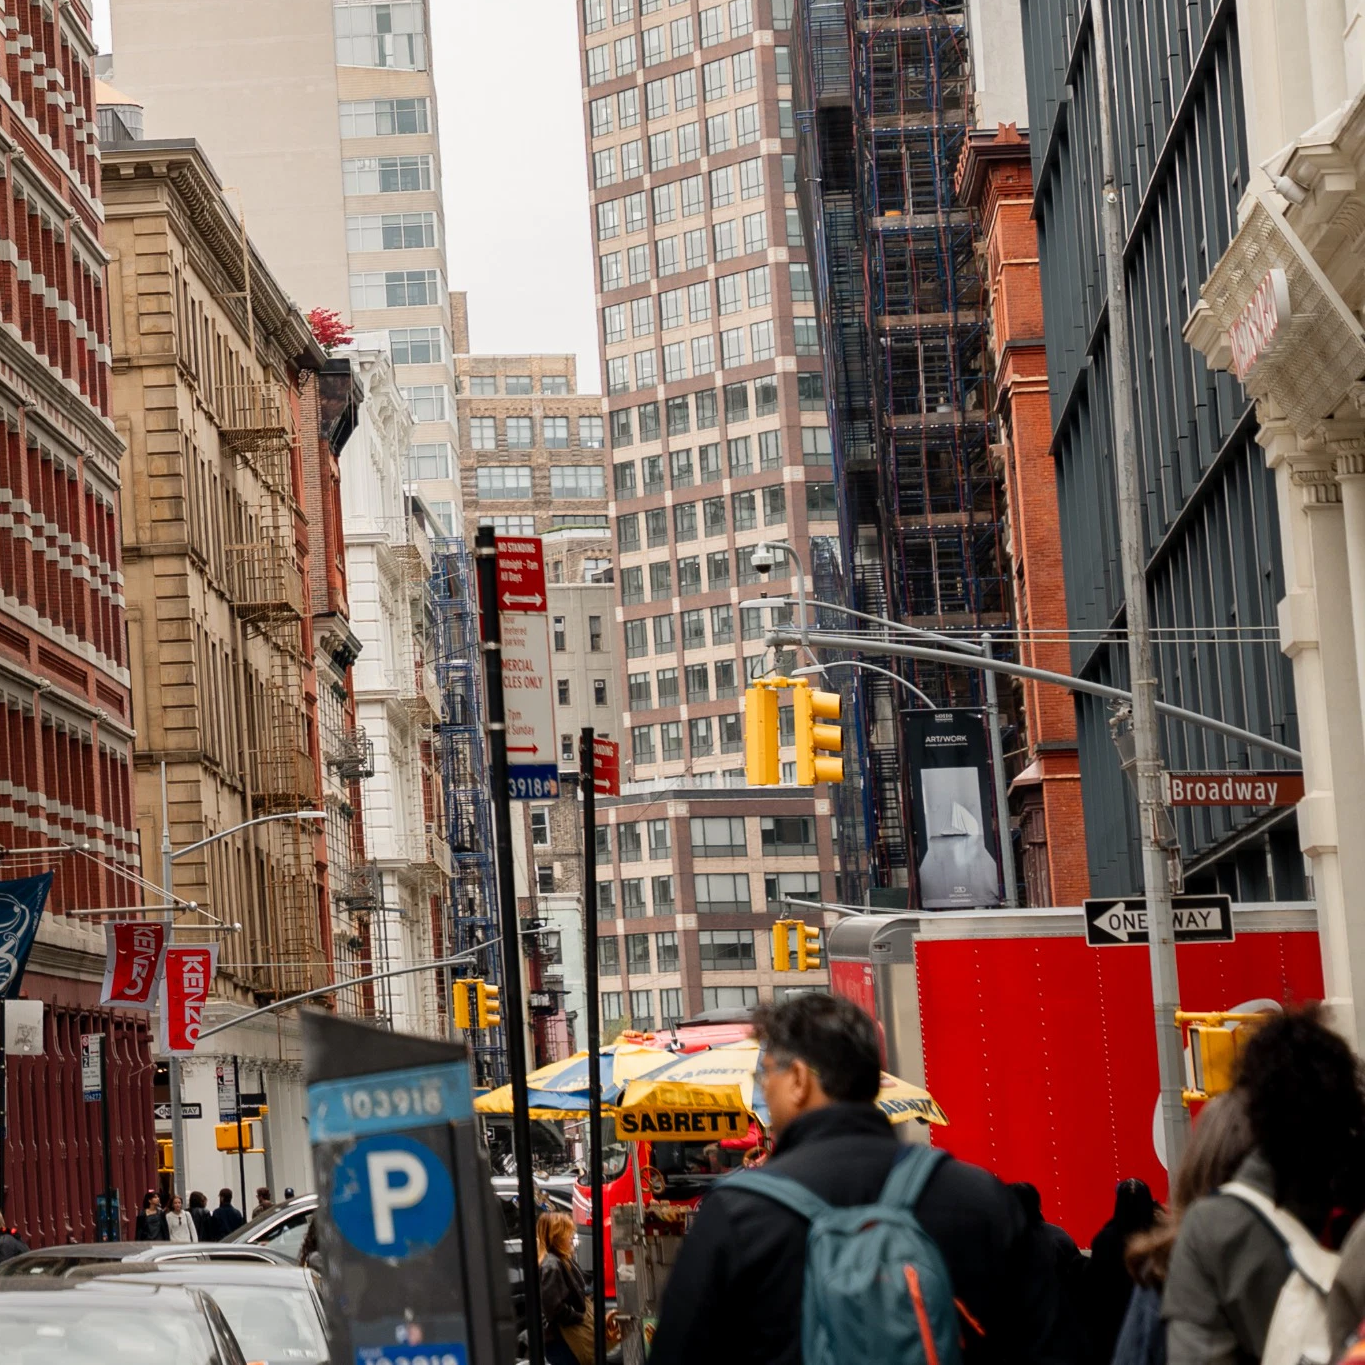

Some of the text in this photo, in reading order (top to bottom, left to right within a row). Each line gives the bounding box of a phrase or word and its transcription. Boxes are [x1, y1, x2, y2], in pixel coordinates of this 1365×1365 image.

[507, 542, 536, 553] STANDING
[501, 659, 535, 672] MERCIAL
[503, 676, 544, 690] CLES ONLY
[594, 743, 614, 757] ANDING
[508, 777, 544, 798] 3918
[1172, 777, 1278, 806] Broadway
[1109, 910, 1212, 931] ONE WAY
[124, 925, 156, 995] KENZO
[182, 955, 205, 1045] KENZO
[182, 1107, 198, 1115] WAY
[622, 1111, 740, 1133] SABRETT
[367, 1150, 429, 1244] P
